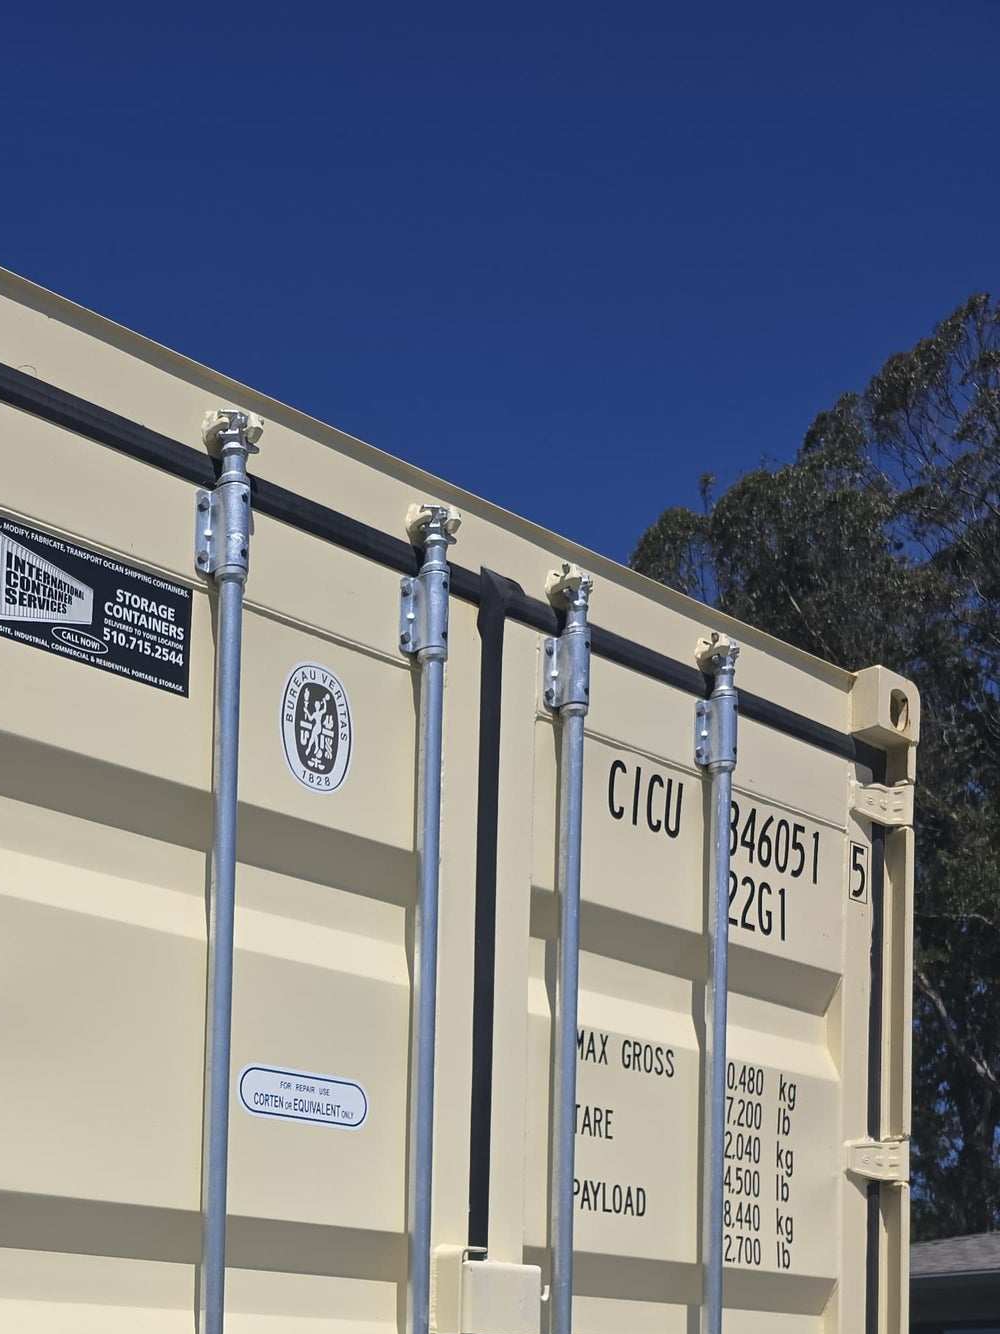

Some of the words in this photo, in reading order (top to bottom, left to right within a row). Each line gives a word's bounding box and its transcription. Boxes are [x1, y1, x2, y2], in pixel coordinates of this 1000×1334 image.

[3, 522, 30, 539] MODIFY,
[31, 533, 66, 553] FABRICATE,
[66, 546, 103, 565] TRANSPORT
[103, 560, 124, 575] OCEAN
[124, 567, 152, 585] SHIPPING
[152, 578, 190, 599] CONTAINERS.
[6, 551, 85, 600] INTERNATIONAL
[5, 570, 73, 605] CONTAINER
[5, 587, 67, 614] SERVICES
[116, 589, 175, 621] STORAGE
[104, 602, 184, 640] CONTAINERS
[104, 618, 133, 633] DELIVERED
[134, 628, 141, 636] TO
[142, 630, 157, 642] YOUR
[158, 637, 184, 651] LOCATION
[14, 627, 50, 649] INDUSTRIAL,
[51, 643, 89, 662] COMMERCIAL
[96, 657, 131, 675] RESIDENTIAL
[131, 670, 158, 684] PORTABLE
[159, 679, 185, 692] STORAGE.
[61, 630, 79, 645] CALL
[80, 636, 100, 651] NOW!
[103, 627, 184, 667] 510.715.2544
[285, 670, 316, 723] BUREAU
[321, 673, 348, 741] VERITAS
[301, 770, 330, 787] 1828
[607, 758, 684, 838] CICU
[851, 845, 866, 898] 5
[728, 870, 786, 942] 22G1
[280, 1080, 292, 1090] FOR
[295, 1084, 315, 1094] REPAIR
[319, 1087, 331, 1097] USE
[576, 1029, 609, 1066] MAX
[621, 1039, 675, 1078] GROSS
[726, 1062, 764, 1096] 0,480
[778, 1073, 797, 1111] kg
[253, 1092, 284, 1109] CORTEN
[285, 1101, 293, 1111] OR
[293, 1098, 341, 1118] EQUIVALENT
[341, 1110, 354, 1120] ONLY
[725, 1095, 762, 1130] 7,200
[777, 1107, 791, 1136] lb
[776, 1140, 794, 1178] kg
[776, 1173, 790, 1203] lb
[723, 1199, 760, 1232] 8,440
[776, 1207, 794, 1244] kg
[724, 1234, 761, 1265] 2,700
[777, 1240, 791, 1270] lb
